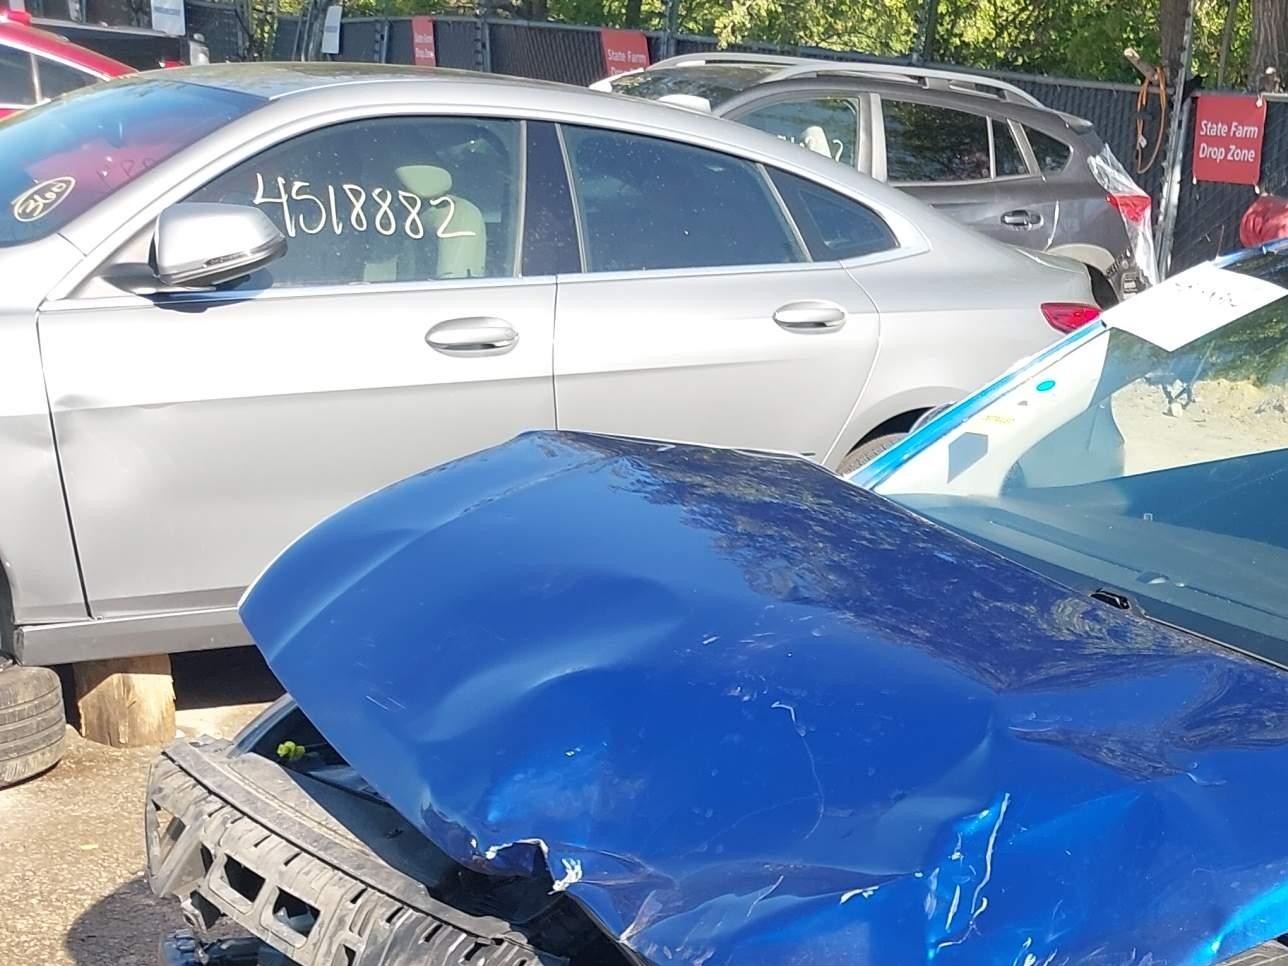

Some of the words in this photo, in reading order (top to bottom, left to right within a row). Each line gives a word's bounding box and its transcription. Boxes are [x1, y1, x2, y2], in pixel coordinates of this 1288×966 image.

[1200, 120, 1228, 137] State
[1230, 122, 1259, 139] Farm
[1199, 143, 1225, 163] Drop
[1226, 145, 1255, 162] Zone
[252, 172, 477, 240] 4518882
